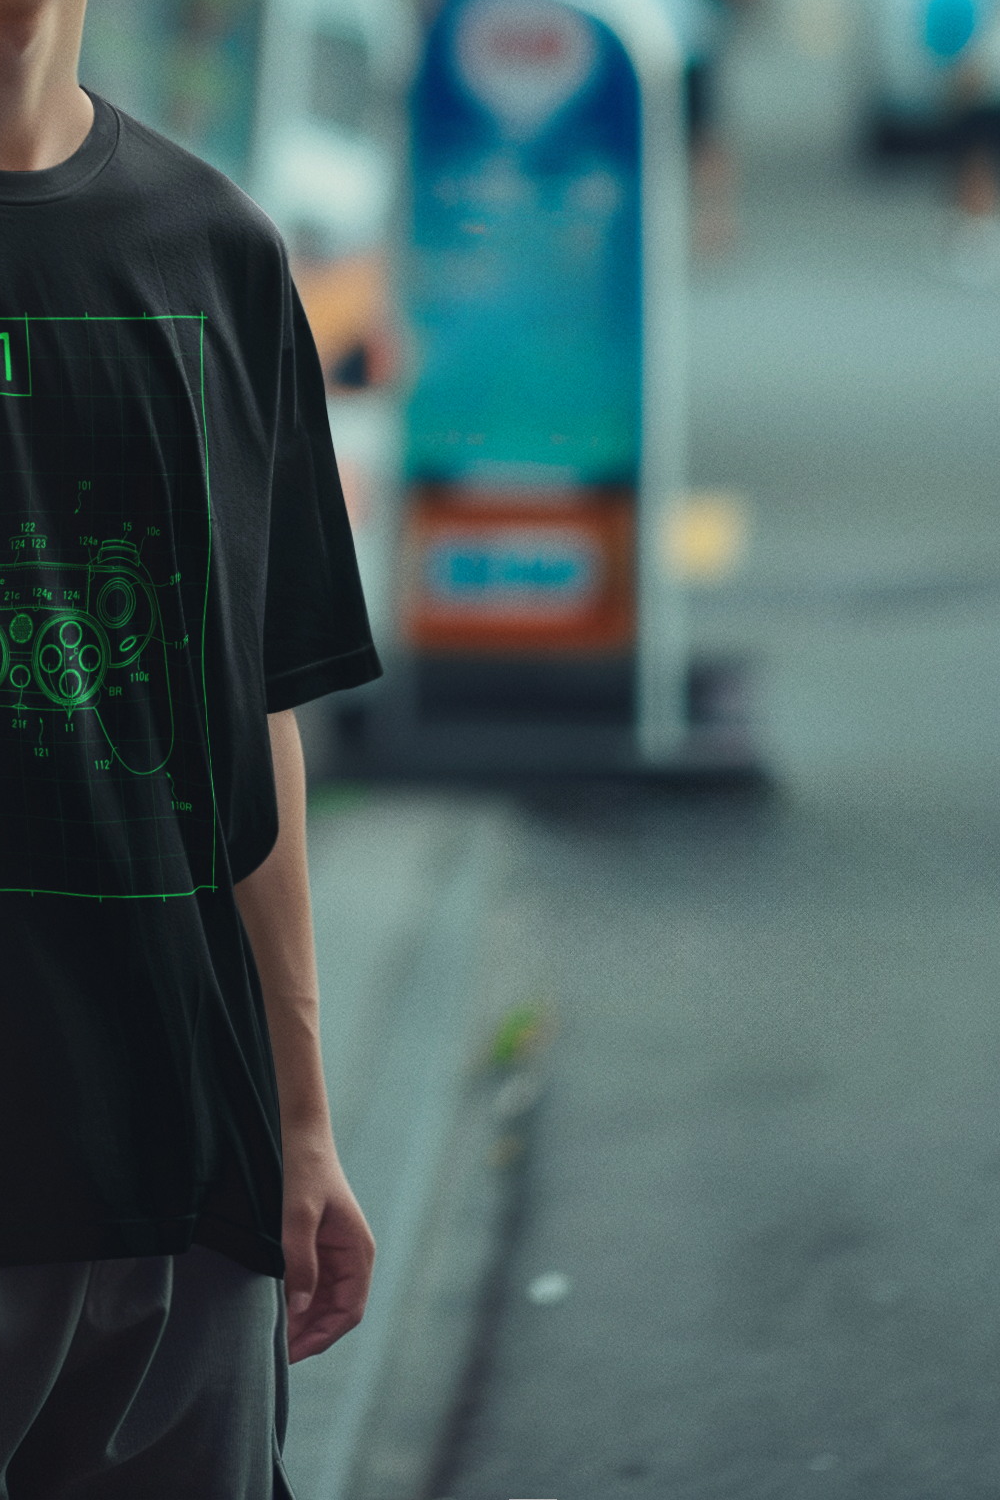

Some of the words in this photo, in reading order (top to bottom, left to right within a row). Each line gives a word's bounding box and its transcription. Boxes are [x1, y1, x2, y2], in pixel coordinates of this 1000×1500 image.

[77, 480, 91, 491] 101
[20, 522, 36, 532] 122
[122, 522, 133, 532] 15
[146, 526, 161, 537] 10c
[10, 539, 25, 550] 124
[31, 538, 47, 549] 123
[79, 536, 98, 546] 124a
[3, 591, 20, 601] 21c
[32, 587, 53, 601] 124g
[63, 590, 80, 600] 124i
[108, 686, 123, 697] BR
[64, 722, 74, 733] 11
[33, 747, 49, 757] 121
[94, 759, 110, 771] 112
[171, 800, 193, 813] 110R
